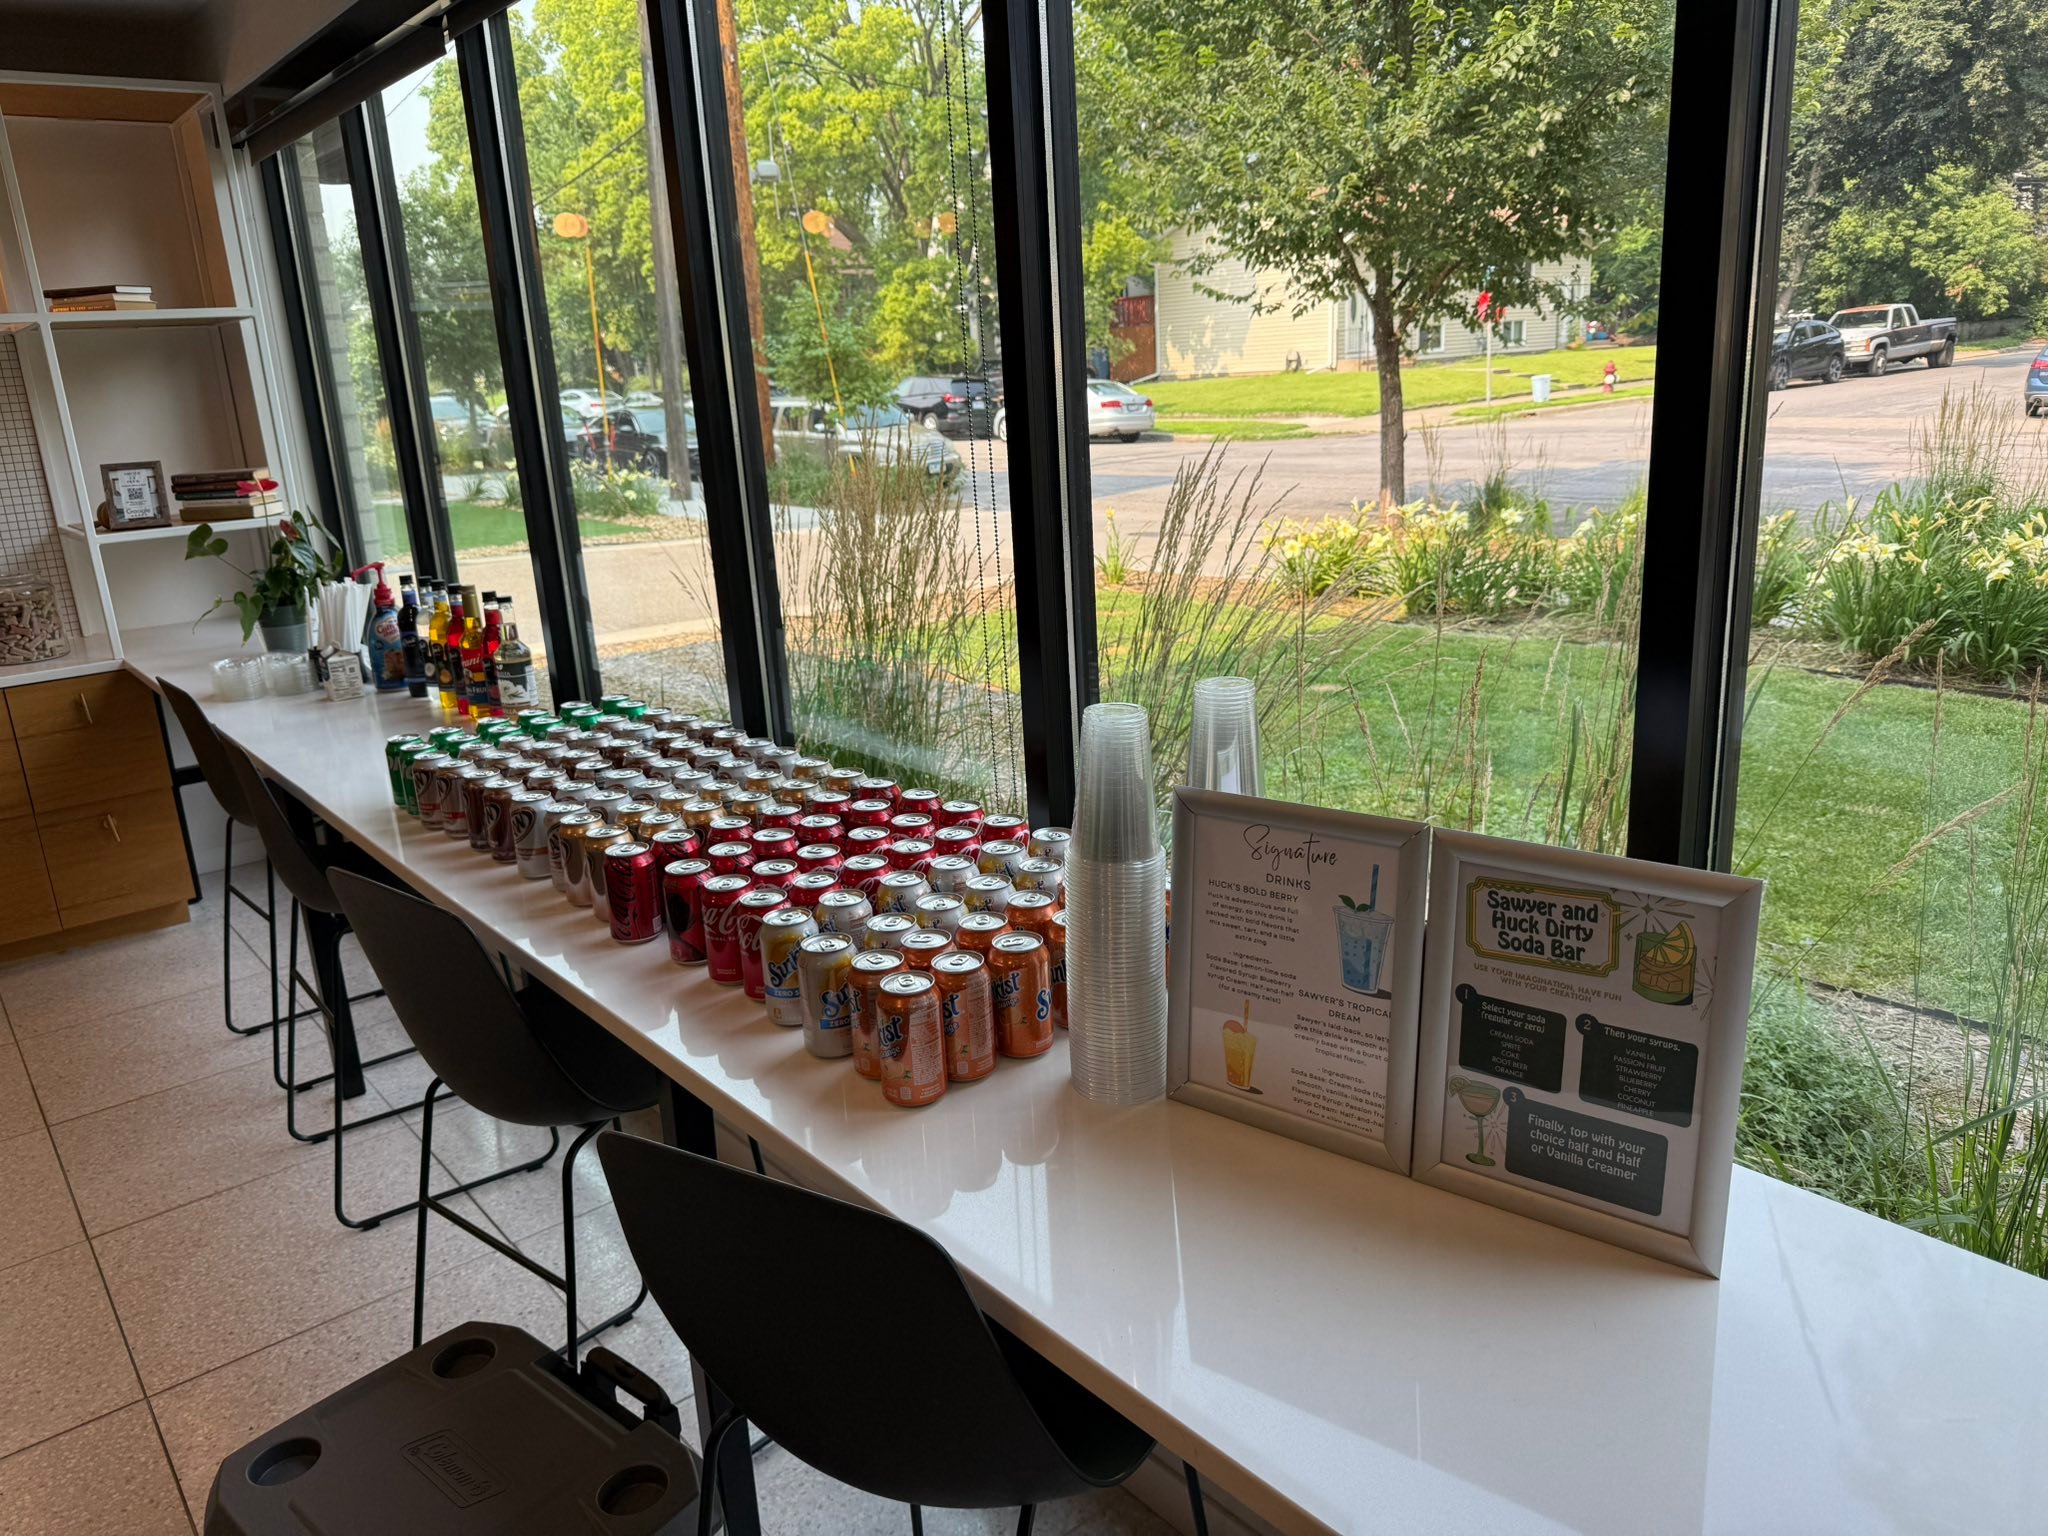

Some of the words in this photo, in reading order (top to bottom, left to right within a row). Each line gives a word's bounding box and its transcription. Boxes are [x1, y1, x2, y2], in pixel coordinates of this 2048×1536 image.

[1243, 823, 1338, 875] Signature
[1265, 873, 1311, 890] DRINKS
[1208, 879, 1241, 892] HUCK'S
[1243, 885, 1267, 897] BOLD
[1269, 890, 1298, 903] BERRY
[1231, 896, 1271, 910] adventurous
[1273, 904, 1286, 913] and
[1487, 889, 1557, 917] Sawyer
[1562, 903, 1599, 923] and
[1255, 909, 1267, 918] this
[1261, 919, 1284, 930] flavors
[1285, 925, 1300, 934] that
[1492, 910, 1540, 935] Huck
[1545, 918, 1594, 942] Dirty
[1497, 930, 1545, 955] Soda
[1551, 938, 1586, 961] Bar
[1206, 953, 1221, 962] Soda
[1280, 972, 1297, 980] soda
[1210, 963, 1237, 975] Flavored
[1260, 975, 1291, 989] Blueberry
[1473, 963, 1489, 972] USE
[1491, 967, 1513, 978] YOUR
[1578, 986, 1601, 997] HAVE
[1604, 991, 1622, 1002] FUN
[1237, 988, 1261, 1000] creamy
[1500, 975, 1521, 987] WITH
[1523, 980, 1548, 993] YOUR
[1550, 986, 1591, 1003] CREATION
[1298, 989, 1344, 1007] SAWYER'S
[1297, 1014, 1326, 1027] Sawyer's
[1328, 1009, 1361, 1023] DREAM
[1481, 1001, 1505, 1014] Select
[1506, 1007, 1527, 1019] your
[1527, 1013, 1546, 1025] soda
[1481, 1011, 1512, 1025] (regular
[1513, 1020, 1523, 1028] or
[1583, 1019, 1592, 1031] 2
[1310, 1027, 1323, 1036] this
[1324, 1030, 1342, 1040] drink
[1350, 1038, 1377, 1049] smooth
[1489, 1029, 1514, 1041] CREAM
[1515, 1035, 1534, 1046] SODA
[1604, 1026, 1626, 1039] Then
[1626, 1032, 1648, 1043] your
[1294, 1033, 1320, 1045] creamy
[1321, 1039, 1338, 1049] base
[1339, 1044, 1354, 1053] with
[1362, 1051, 1381, 1060] burst
[1315, 1047, 1342, 1060] tropical
[1500, 1040, 1521, 1050] SPRITE
[1491, 1055, 1512, 1066] ROOT
[1512, 1060, 1529, 1071] BEER
[1500, 1050, 1520, 1060] COKE
[1625, 1048, 1656, 1061] VANILLA
[1494, 1065, 1523, 1079] ORANGE
[1613, 1054, 1645, 1069] PASSION
[1646, 1063, 1666, 1073] FRUIT
[1291, 1067, 1307, 1077] Soda
[1328, 1079, 1352, 1090] Cream
[1354, 1086, 1371, 1095] soda
[1615, 1064, 1663, 1081] STRAWBERRY
[1618, 1074, 1658, 1090] BLUEBERRY
[1510, 1092, 1518, 1103] 3
[1617, 1092, 1656, 1108] COCONUT
[1623, 1085, 1651, 1098] CHERRY
[1291, 1086, 1320, 1099] Flavored
[1345, 1102, 1372, 1115] Passion
[1617, 1101, 1655, 1117] PINEAPPLE
[1530, 1129, 1565, 1147] choice
[1567, 1138, 1590, 1154] half
[1591, 1146, 1613, 1160] and
[1616, 1152, 1641, 1168] Half
[1570, 1126, 1588, 1139] top
[1591, 1133, 1616, 1147] with
[1618, 1139, 1646, 1155] your
[1531, 1143, 1544, 1154] or
[1546, 1145, 1584, 1166] Vanilla
[1586, 1158, 1637, 1181] Creamer
